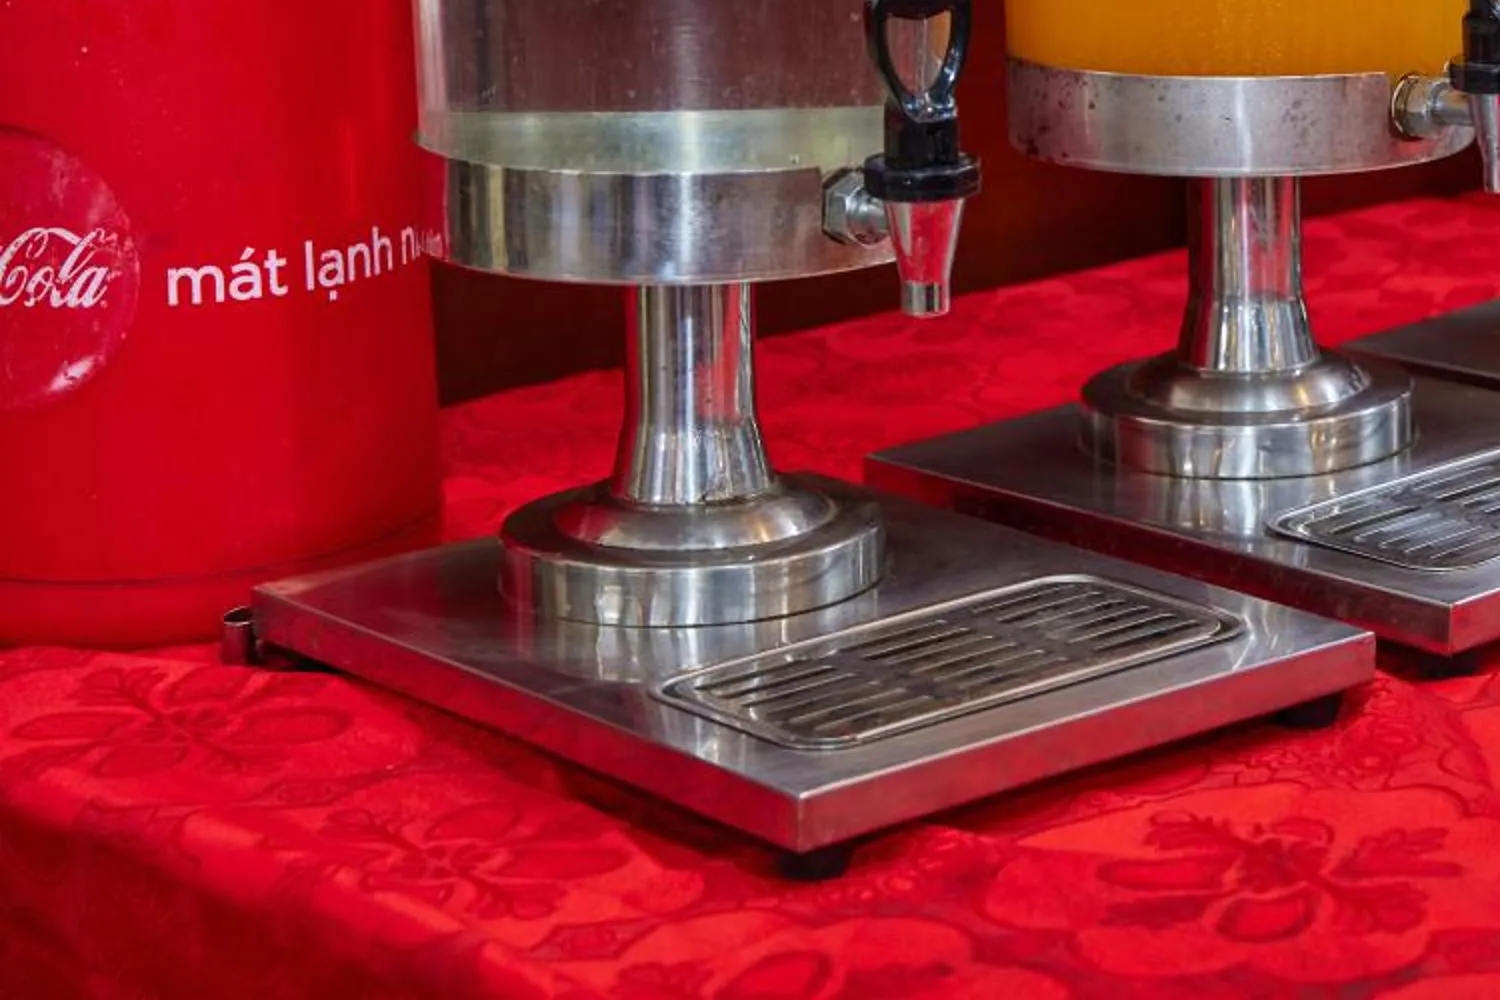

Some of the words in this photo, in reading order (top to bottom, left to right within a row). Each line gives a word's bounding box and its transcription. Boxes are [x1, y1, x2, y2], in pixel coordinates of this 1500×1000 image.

[0, 227, 108, 308] Cola
[167, 246, 288, 306] mát
[304, 225, 393, 301] lạnh
